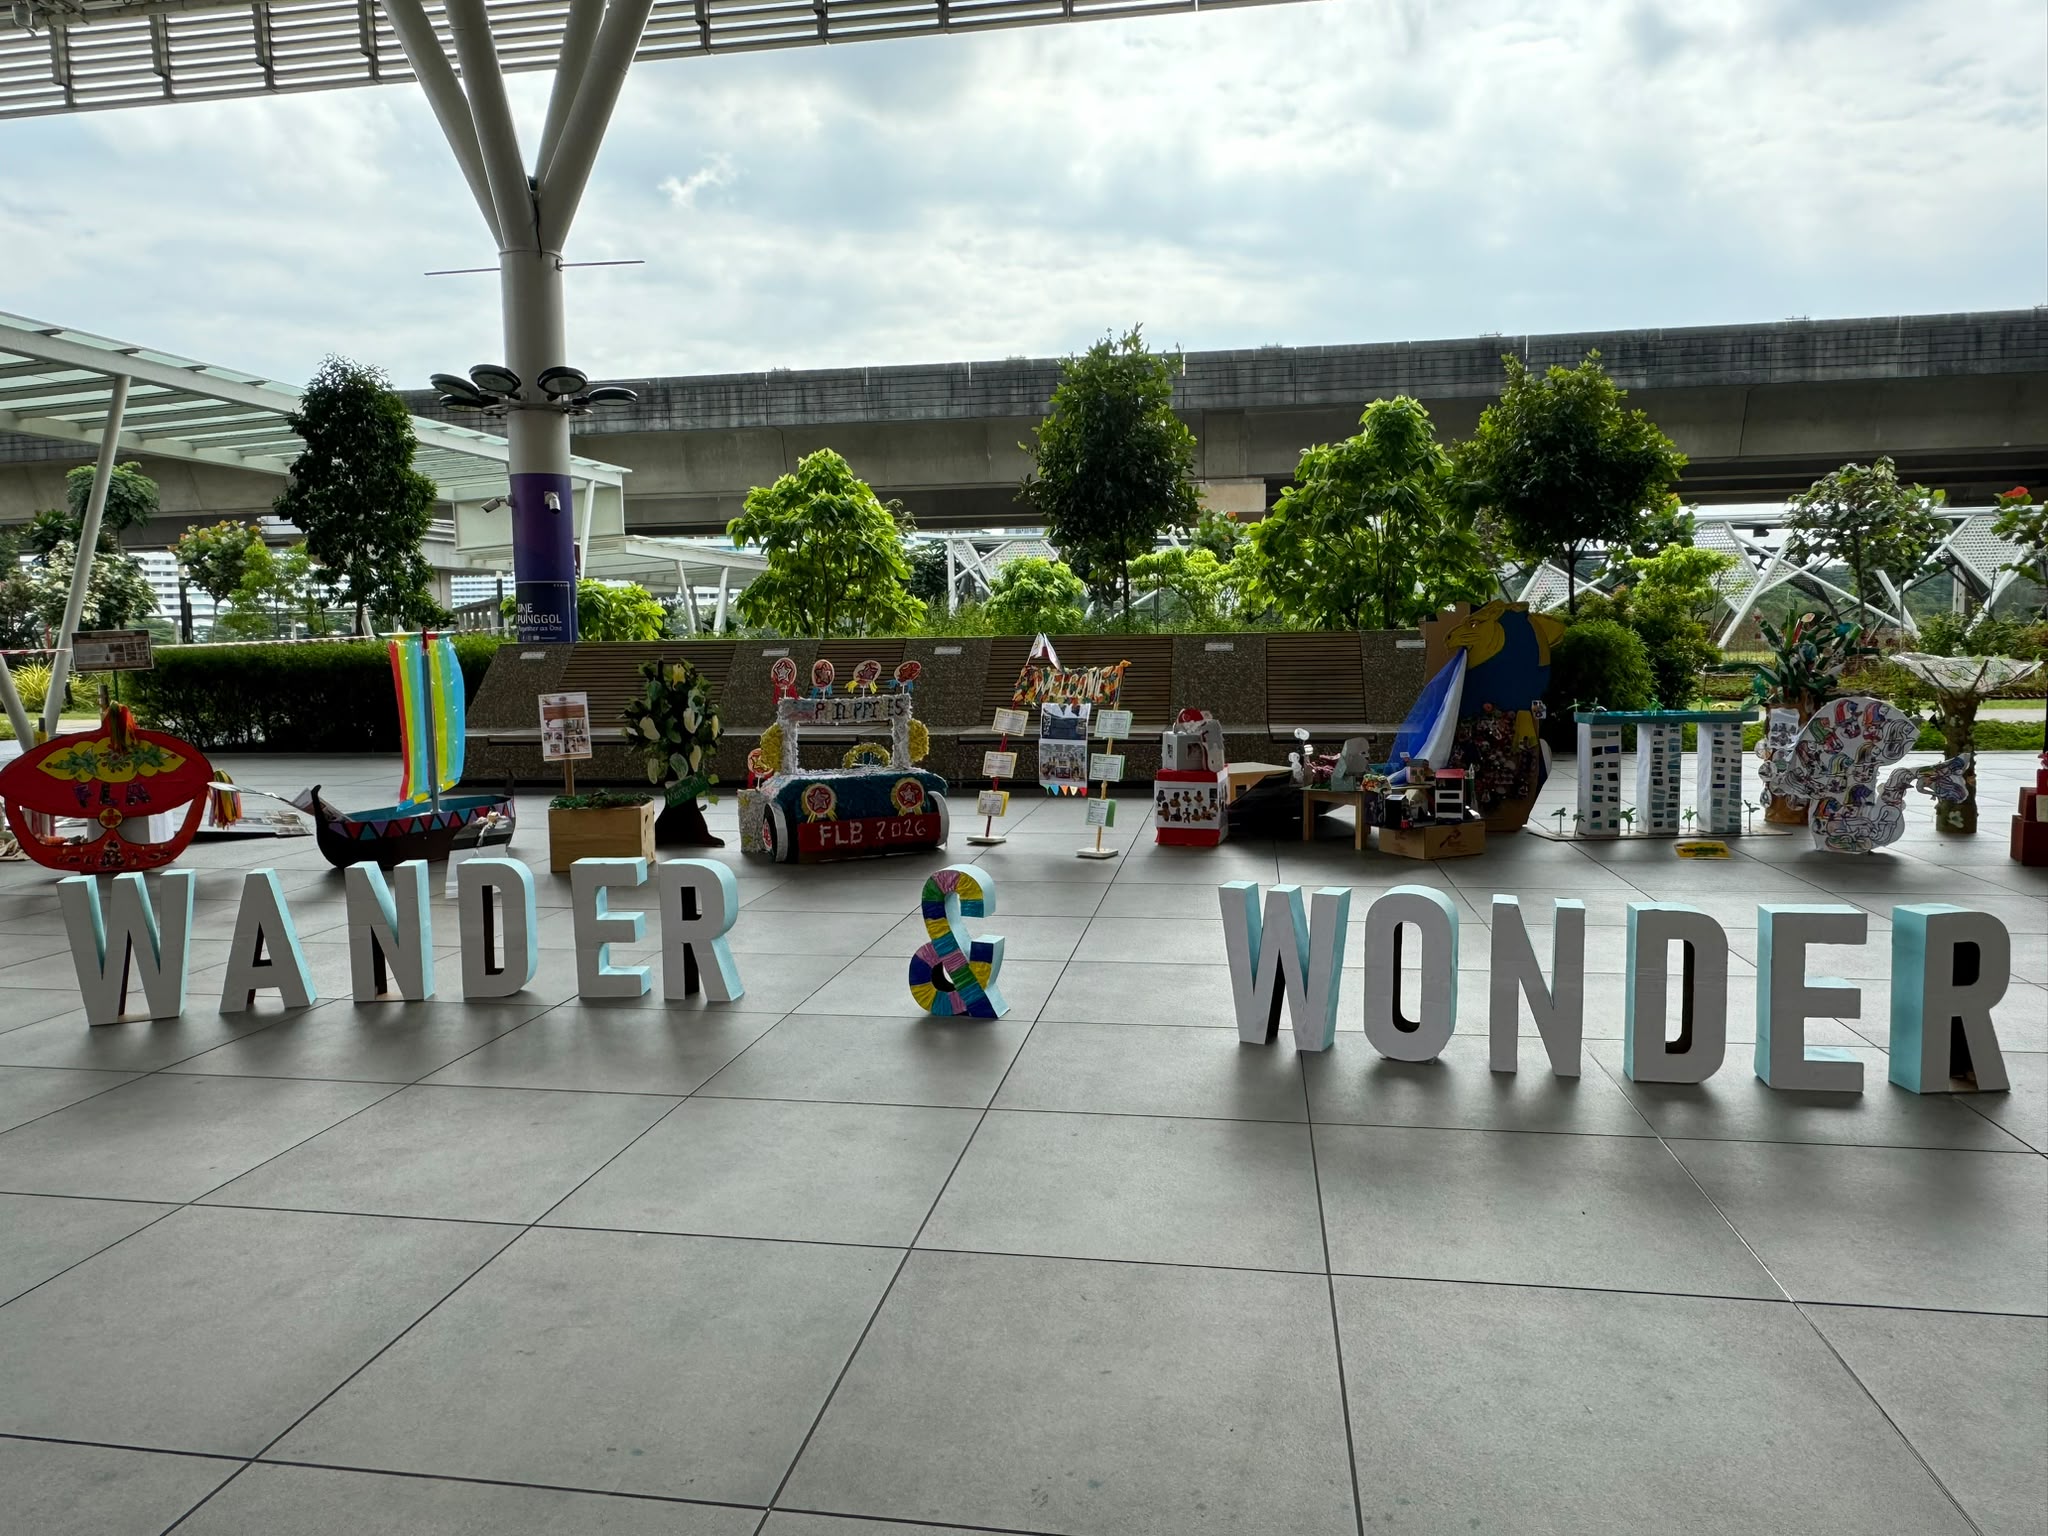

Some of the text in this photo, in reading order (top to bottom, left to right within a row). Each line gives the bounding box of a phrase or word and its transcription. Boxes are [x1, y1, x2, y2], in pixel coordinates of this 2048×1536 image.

[1035, 666, 1114, 700] WELCOME
[819, 818, 926, 846] FLB 2026
[57, 857, 2010, 1094] WANDER & WONDER
